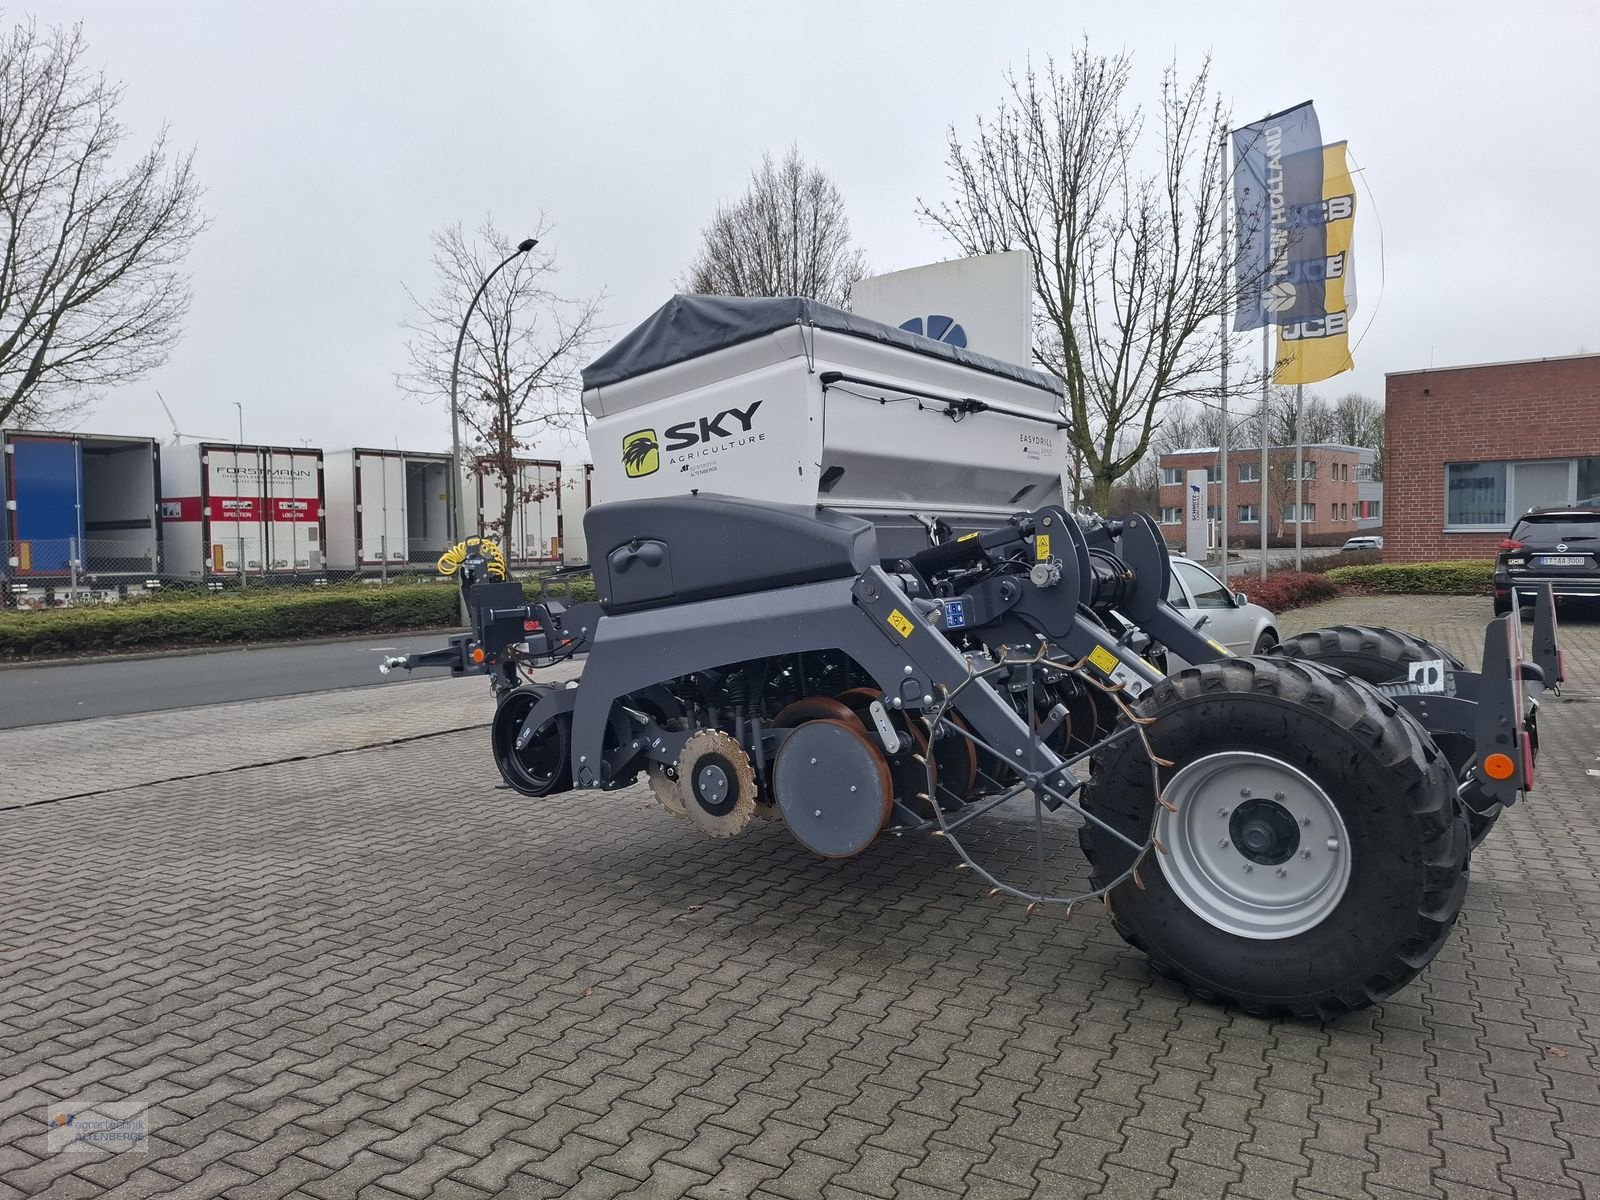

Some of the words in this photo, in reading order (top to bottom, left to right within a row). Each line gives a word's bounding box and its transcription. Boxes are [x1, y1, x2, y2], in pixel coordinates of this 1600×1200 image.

[1265, 126, 1287, 224] HOLLAND
[1270, 228, 1288, 275] NEW
[1282, 312, 1348, 340] JCB
[664, 400, 764, 452] SKY
[1020, 434, 1053, 447] EASYDRILL
[669, 433, 766, 465] AGRICULTURE
[216, 467, 311, 477] FORSTMANN
[1567, 557, 1584, 565] 3000
